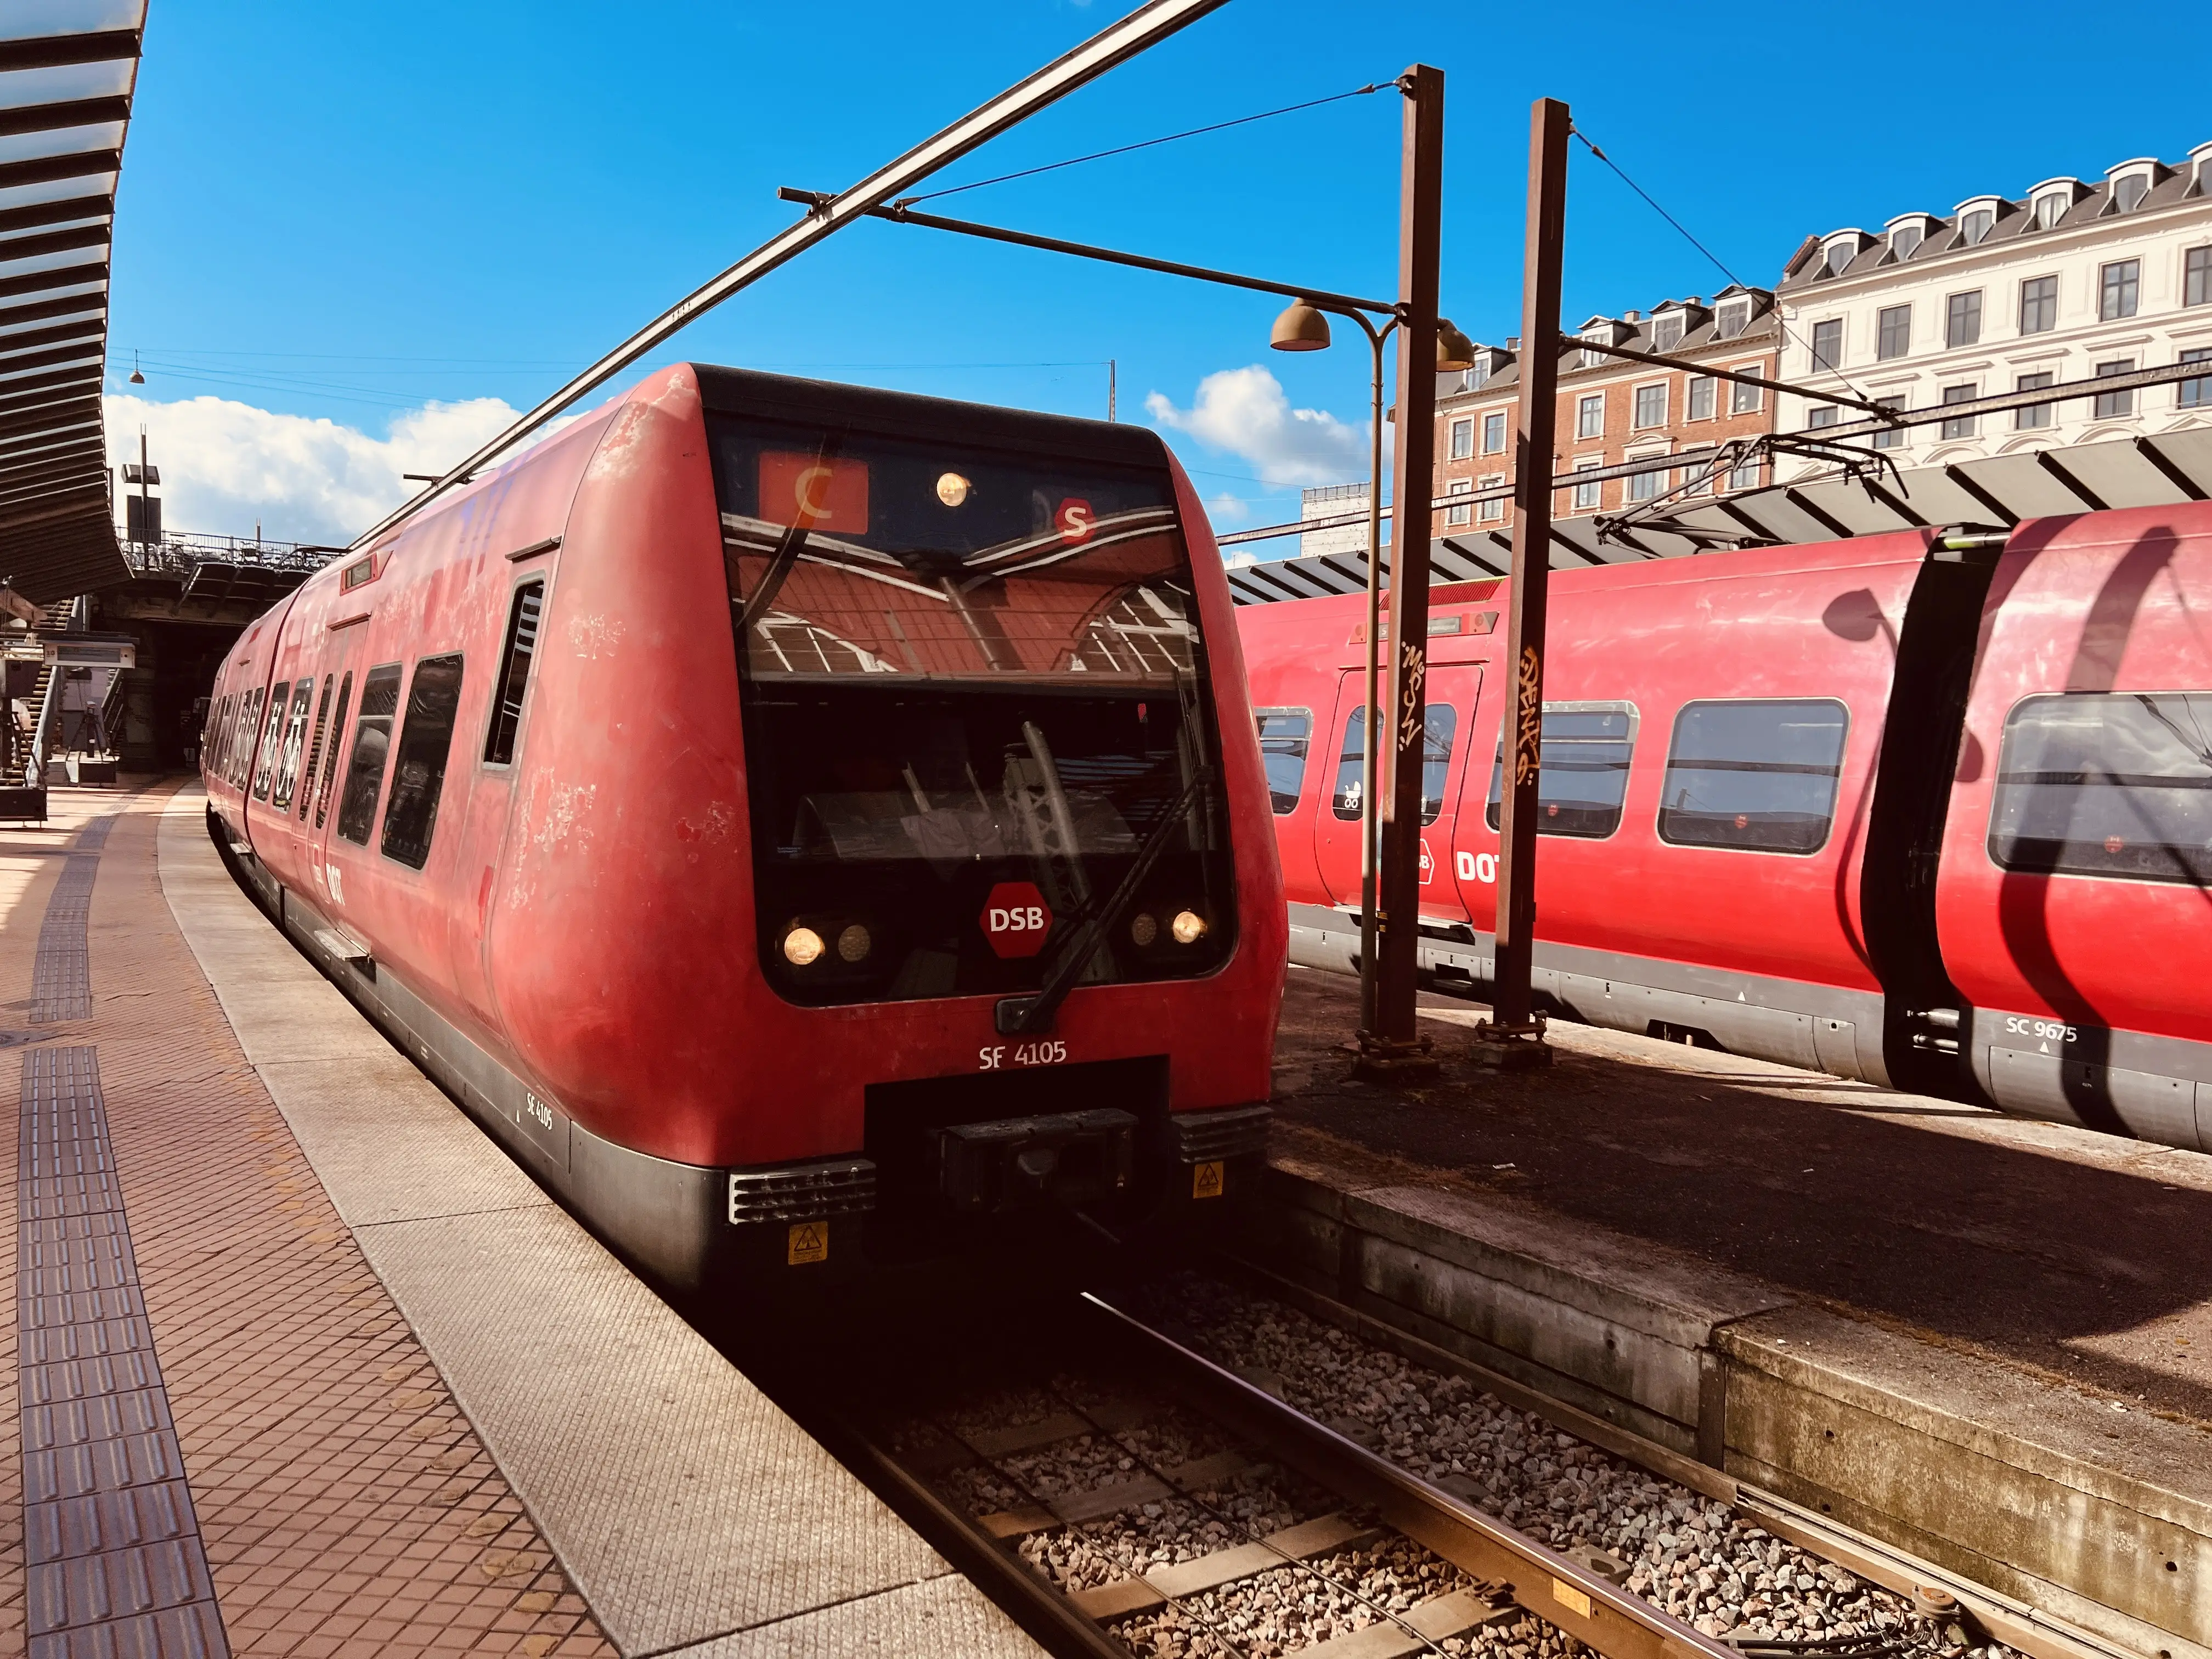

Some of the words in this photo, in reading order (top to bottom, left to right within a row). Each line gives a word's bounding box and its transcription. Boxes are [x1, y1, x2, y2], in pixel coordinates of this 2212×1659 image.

[795, 467, 832, 518] C
[1065, 507, 1087, 537] S
[1457, 851, 1499, 883] DO
[990, 907, 1044, 932] DSB
[2006, 1017, 2030, 1035] SC
[2034, 1021, 2077, 1042] 9675
[979, 1046, 1006, 1069] SF
[1014, 1041, 1066, 1065] 4105
[527, 1092, 535, 1116] SE
[536, 1101, 552, 1130] 4105
